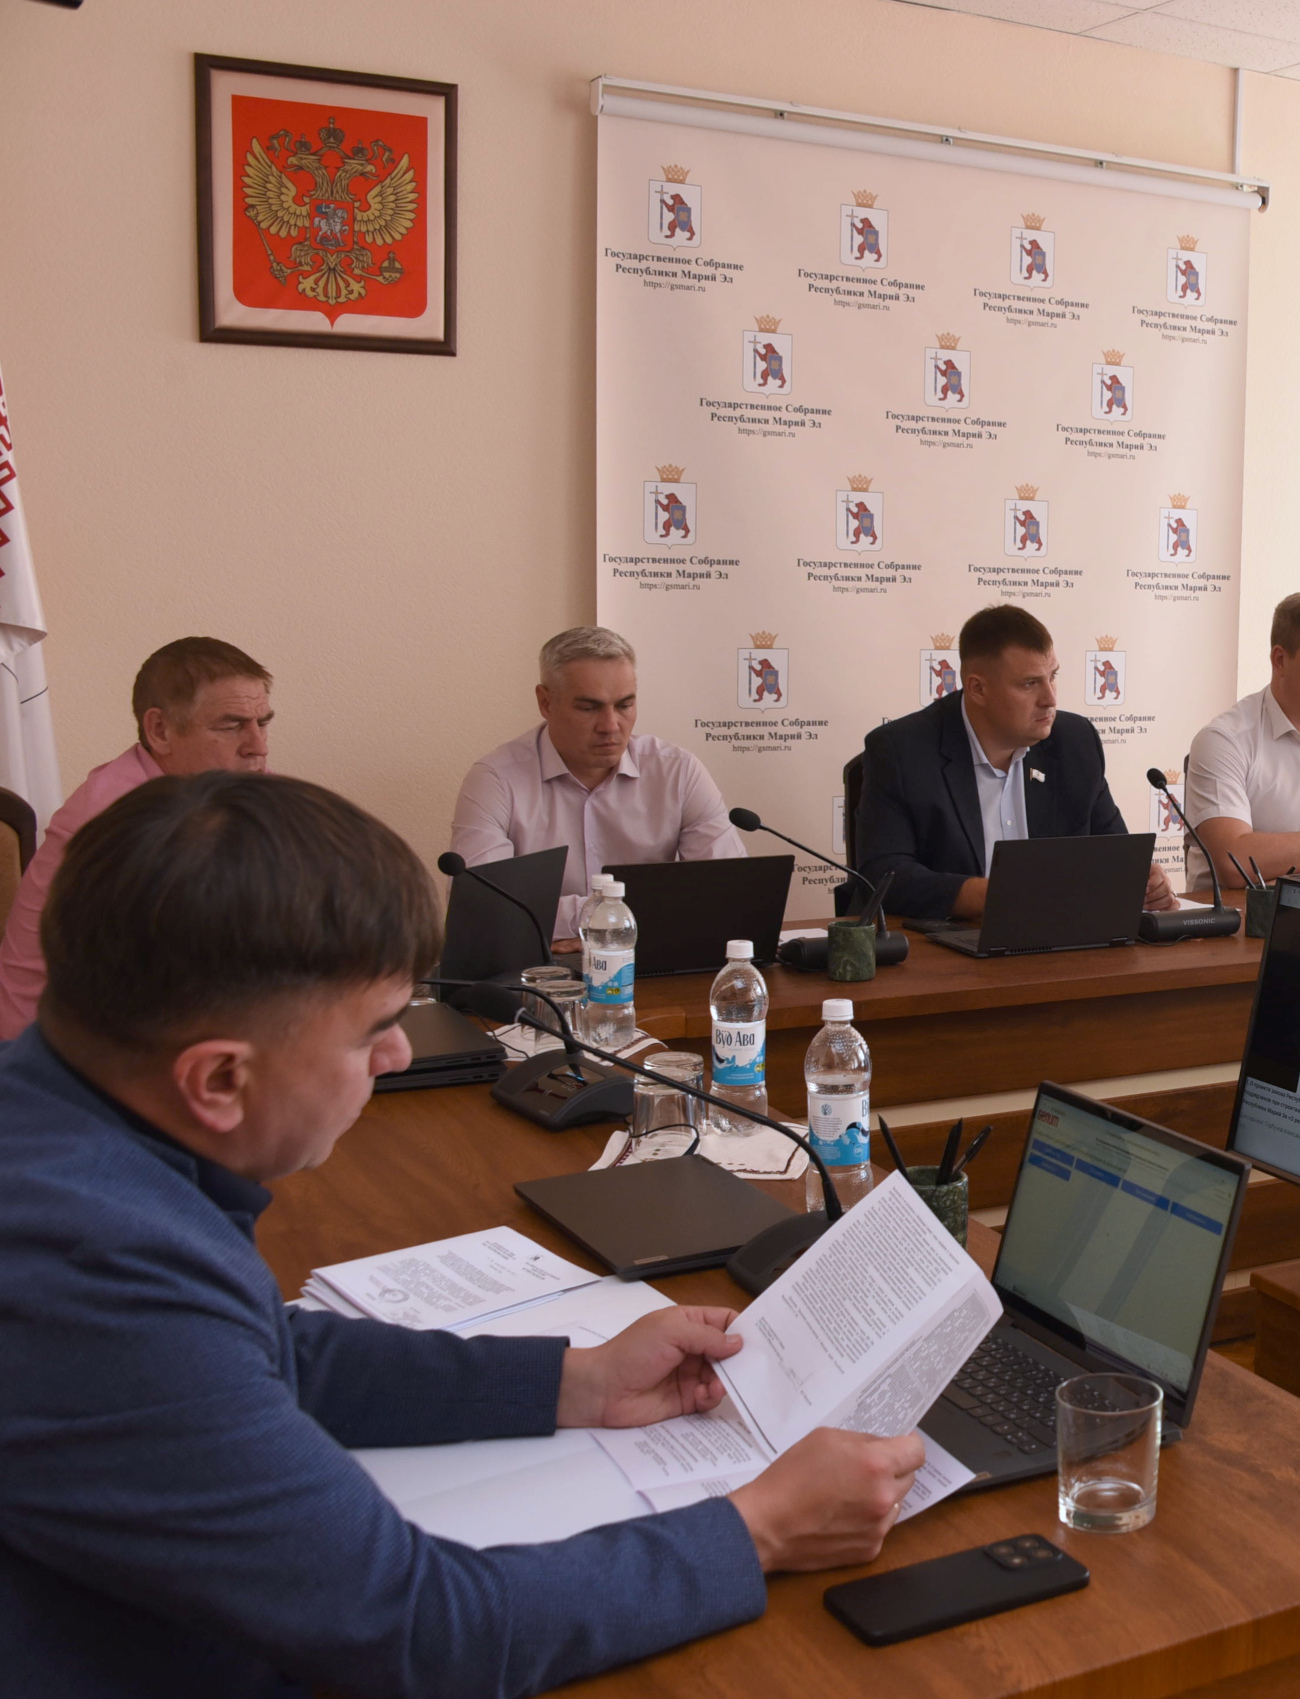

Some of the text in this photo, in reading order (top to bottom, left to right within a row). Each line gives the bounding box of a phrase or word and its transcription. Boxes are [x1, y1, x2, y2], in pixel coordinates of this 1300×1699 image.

[604, 247, 744, 271] Государственное Собрание
[615, 263, 733, 283] Республики Марий Эл
[798, 268, 925, 290] Государственное Собрание
[808, 283, 915, 302] Республики Марий Эл
[973, 288, 1089, 309] Государственное Собрание
[983, 302, 1080, 320] Республики Марий Эл
[1132, 306, 1238, 326] Государственное Собрание
[1140, 319, 1229, 337] Республики Марий Эл
[699, 397, 832, 416] Государственное Собрание
[710, 412, 821, 428] Республики Марий Эл
[885, 410, 1007, 428] Государственное Собрание
[895, 424, 997, 440] Республики Марий Эл
[1056, 423, 1166, 440] Государственное Собрание
[1065, 437, 1157, 451] Республики Марий Эл
[603, 554, 740, 567] Государственное Собрание
[797, 558, 922, 572] Государственное Собрание
[613, 568, 728, 581] Республики Марий Эл
[807, 572, 912, 584] Республики Марий Эл
[968, 564, 1083, 577] Государственное Собрание
[1126, 569, 1231, 582] Государственное Собрание
[977, 577, 1074, 590] Республики Марий Эл
[1134, 581, 1221, 593] Республики Марий Эл
[694, 718, 829, 730] Государственное Собрание
[1118, 714, 1156, 723] Собрание
[705, 731, 818, 743] Республики Марий Эл
[1108, 726, 1134, 736] Марий
[1137, 726, 1147, 734] Эл
[802, 876, 846, 886] Республи
[593, 956, 607, 971] Ава
[735, 1031, 755, 1047] Ава
